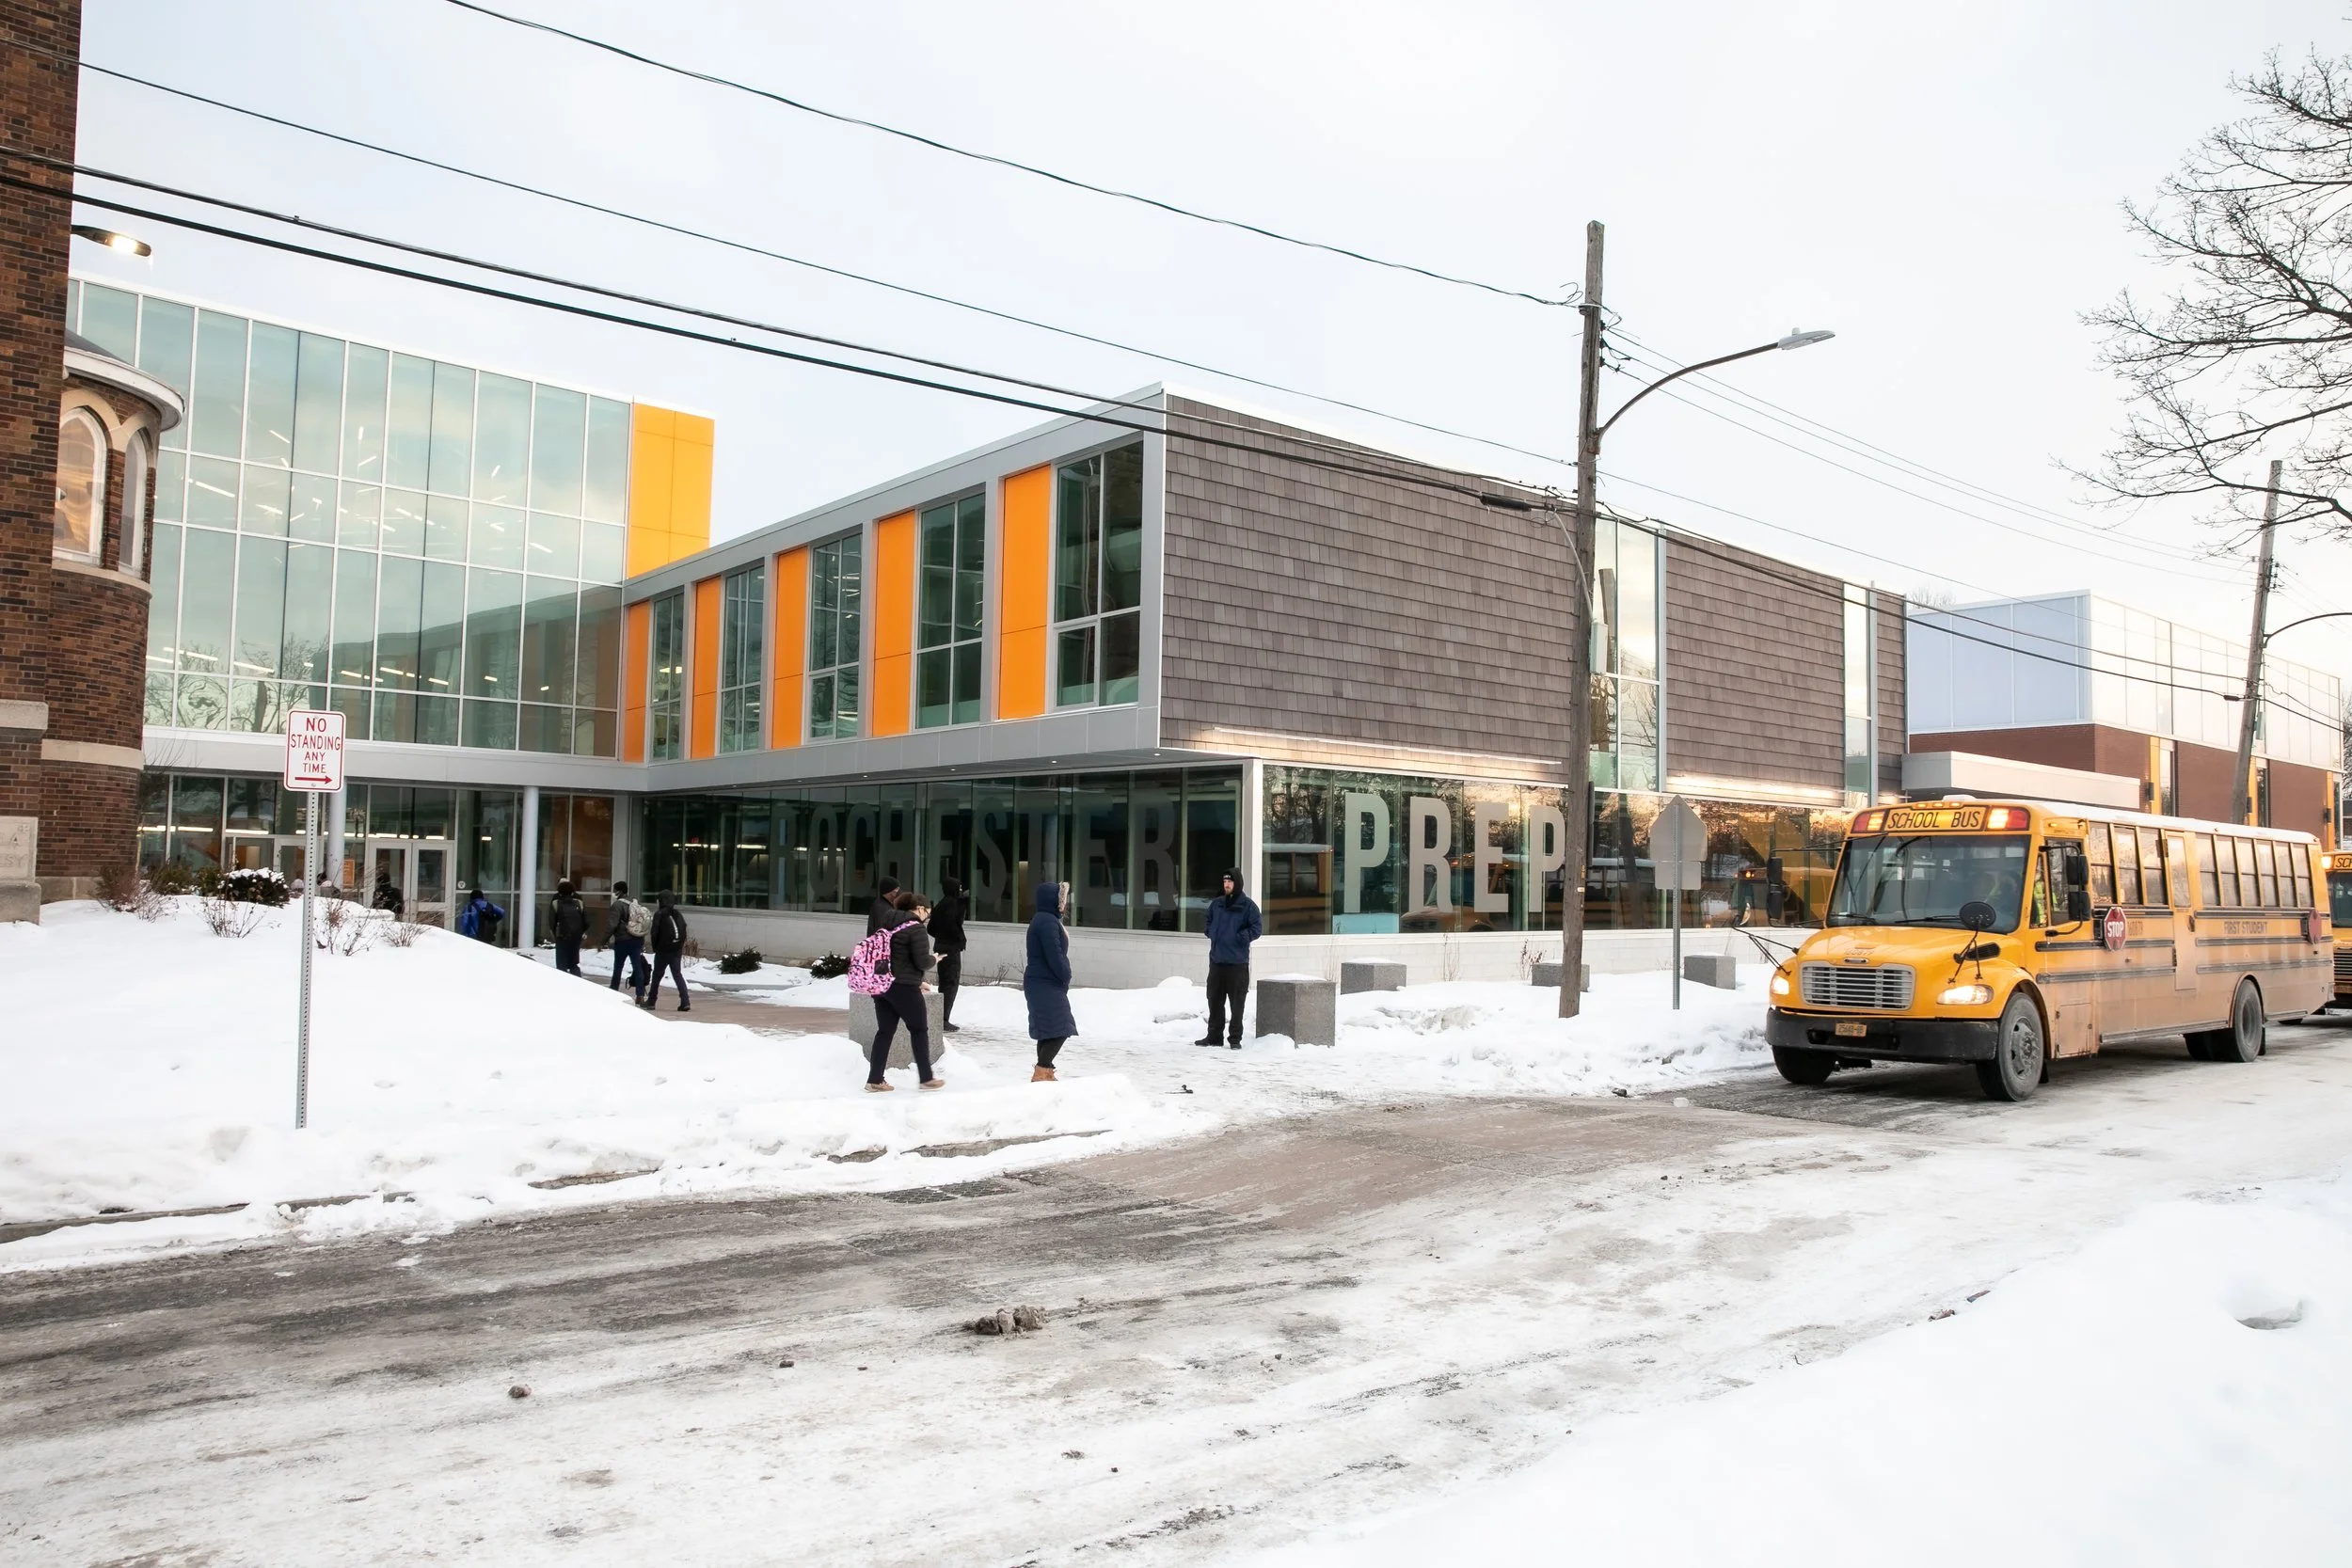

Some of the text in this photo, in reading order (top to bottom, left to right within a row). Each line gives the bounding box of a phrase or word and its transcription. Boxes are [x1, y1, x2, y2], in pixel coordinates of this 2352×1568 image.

[307, 718, 326, 732] NO
[291, 734, 341, 751] STANDING
[305, 752, 326, 761] ANY
[303, 763, 326, 773] TIME
[1887, 811, 1980, 829] SCHOOL BUS
[771, 789, 1180, 909] ROCHESTER
[1343, 792, 1566, 913] PREP
[2107, 921, 2124, 938] STOP
[2224, 921, 2267, 934] FIRST STUDENT
